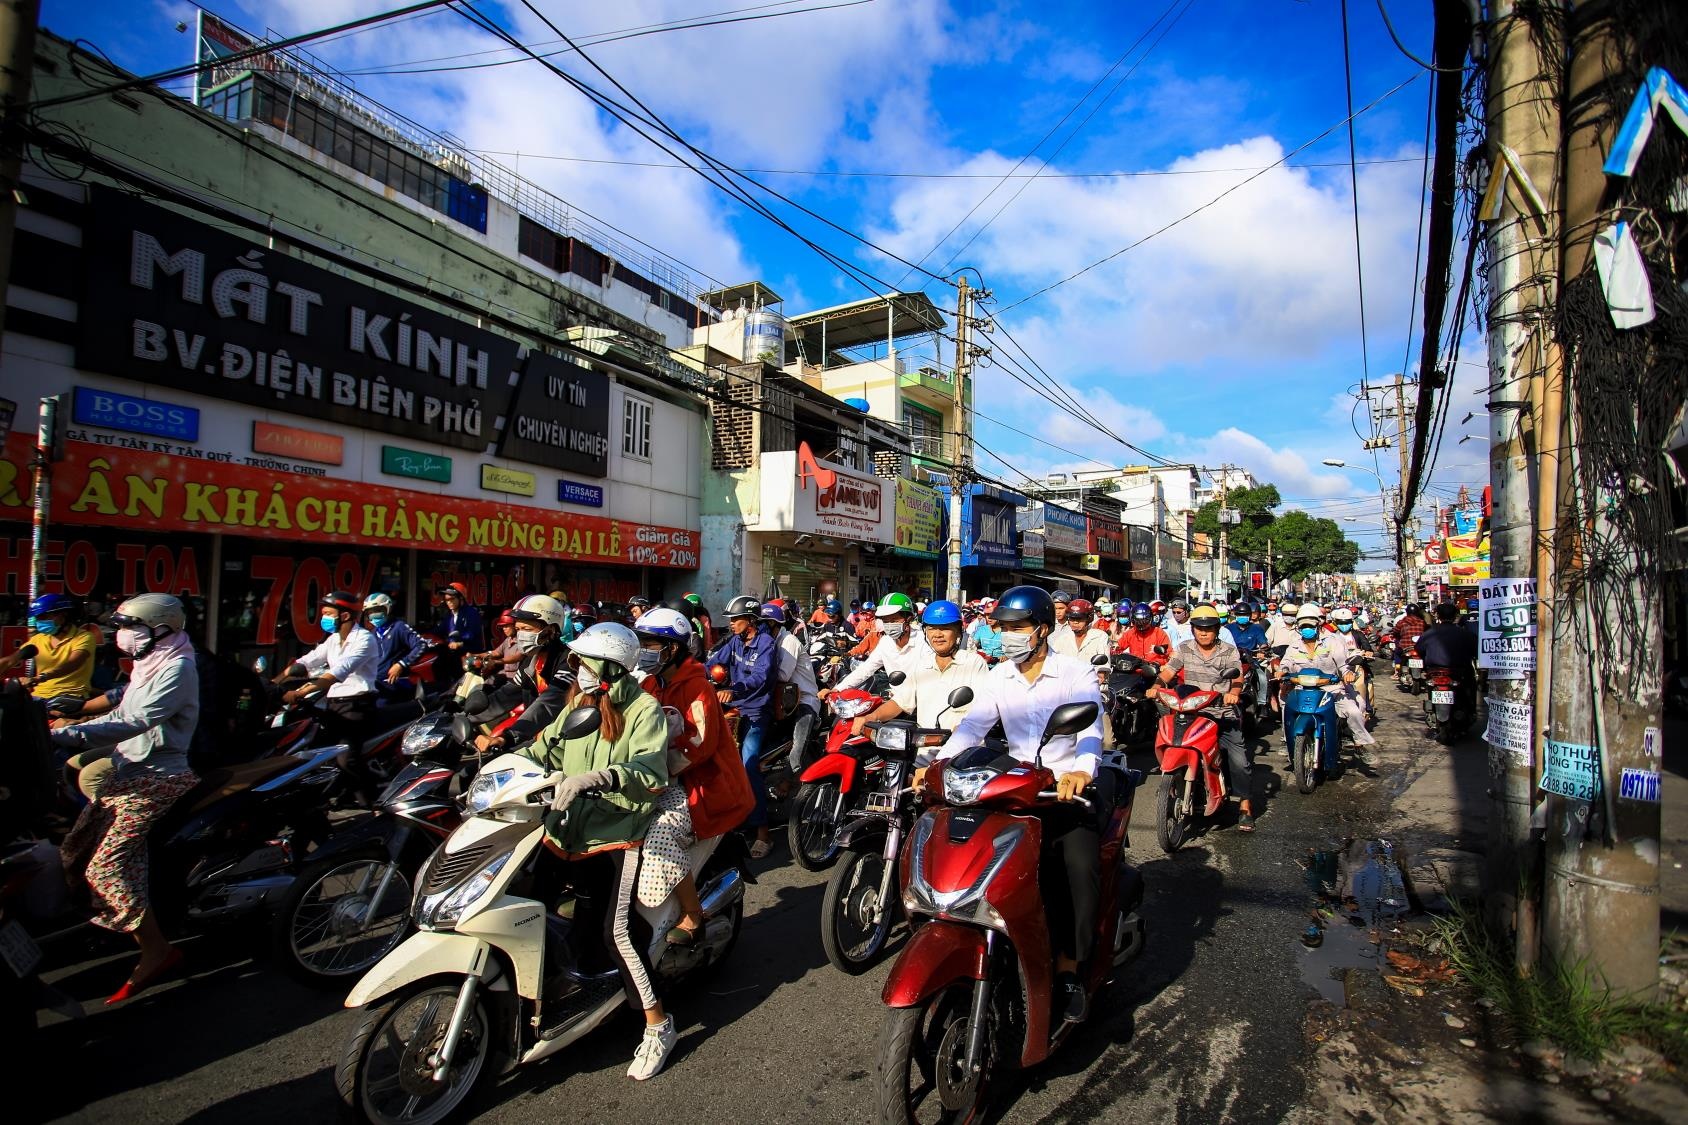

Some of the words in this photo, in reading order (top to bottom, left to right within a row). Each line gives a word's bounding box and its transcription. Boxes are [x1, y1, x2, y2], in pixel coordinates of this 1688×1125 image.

[130, 230, 323, 336] MẮT
[350, 306, 488, 389] KÍNH
[548, 376, 567, 399] UY
[568, 380, 586, 407] TÍN
[93, 395, 185, 425] BOSS
[332, 372, 414, 421] BIÊN
[424, 400, 481, 437] PHỦ
[518, 414, 568, 448] CHUYÊN
[569, 429, 608, 462] NGHIỆP
[394, 456, 442, 474] Ray-Ban
[565, 484, 600, 498] VERSACE
[70, 458, 168, 518] ÂN
[182, 483, 352, 535] KHÁCH
[362, 499, 460, 544] HÀNG
[468, 512, 546, 551] MỪNG
[553, 525, 592, 559] ĐẠI
[597, 519, 621, 557] LỄ
[636, 526, 669, 545] Giảm
[671, 529, 691, 547] Giá
[627, 545, 658, 565] 10%
[669, 547, 697, 567] 20%
[115, 543, 201, 597] TOA
[1482, 582, 1508, 599] ĐẤT
[1487, 608, 1529, 628] 650
[954, 815, 975, 823] HONDA
[514, 913, 541, 927] HONDA
